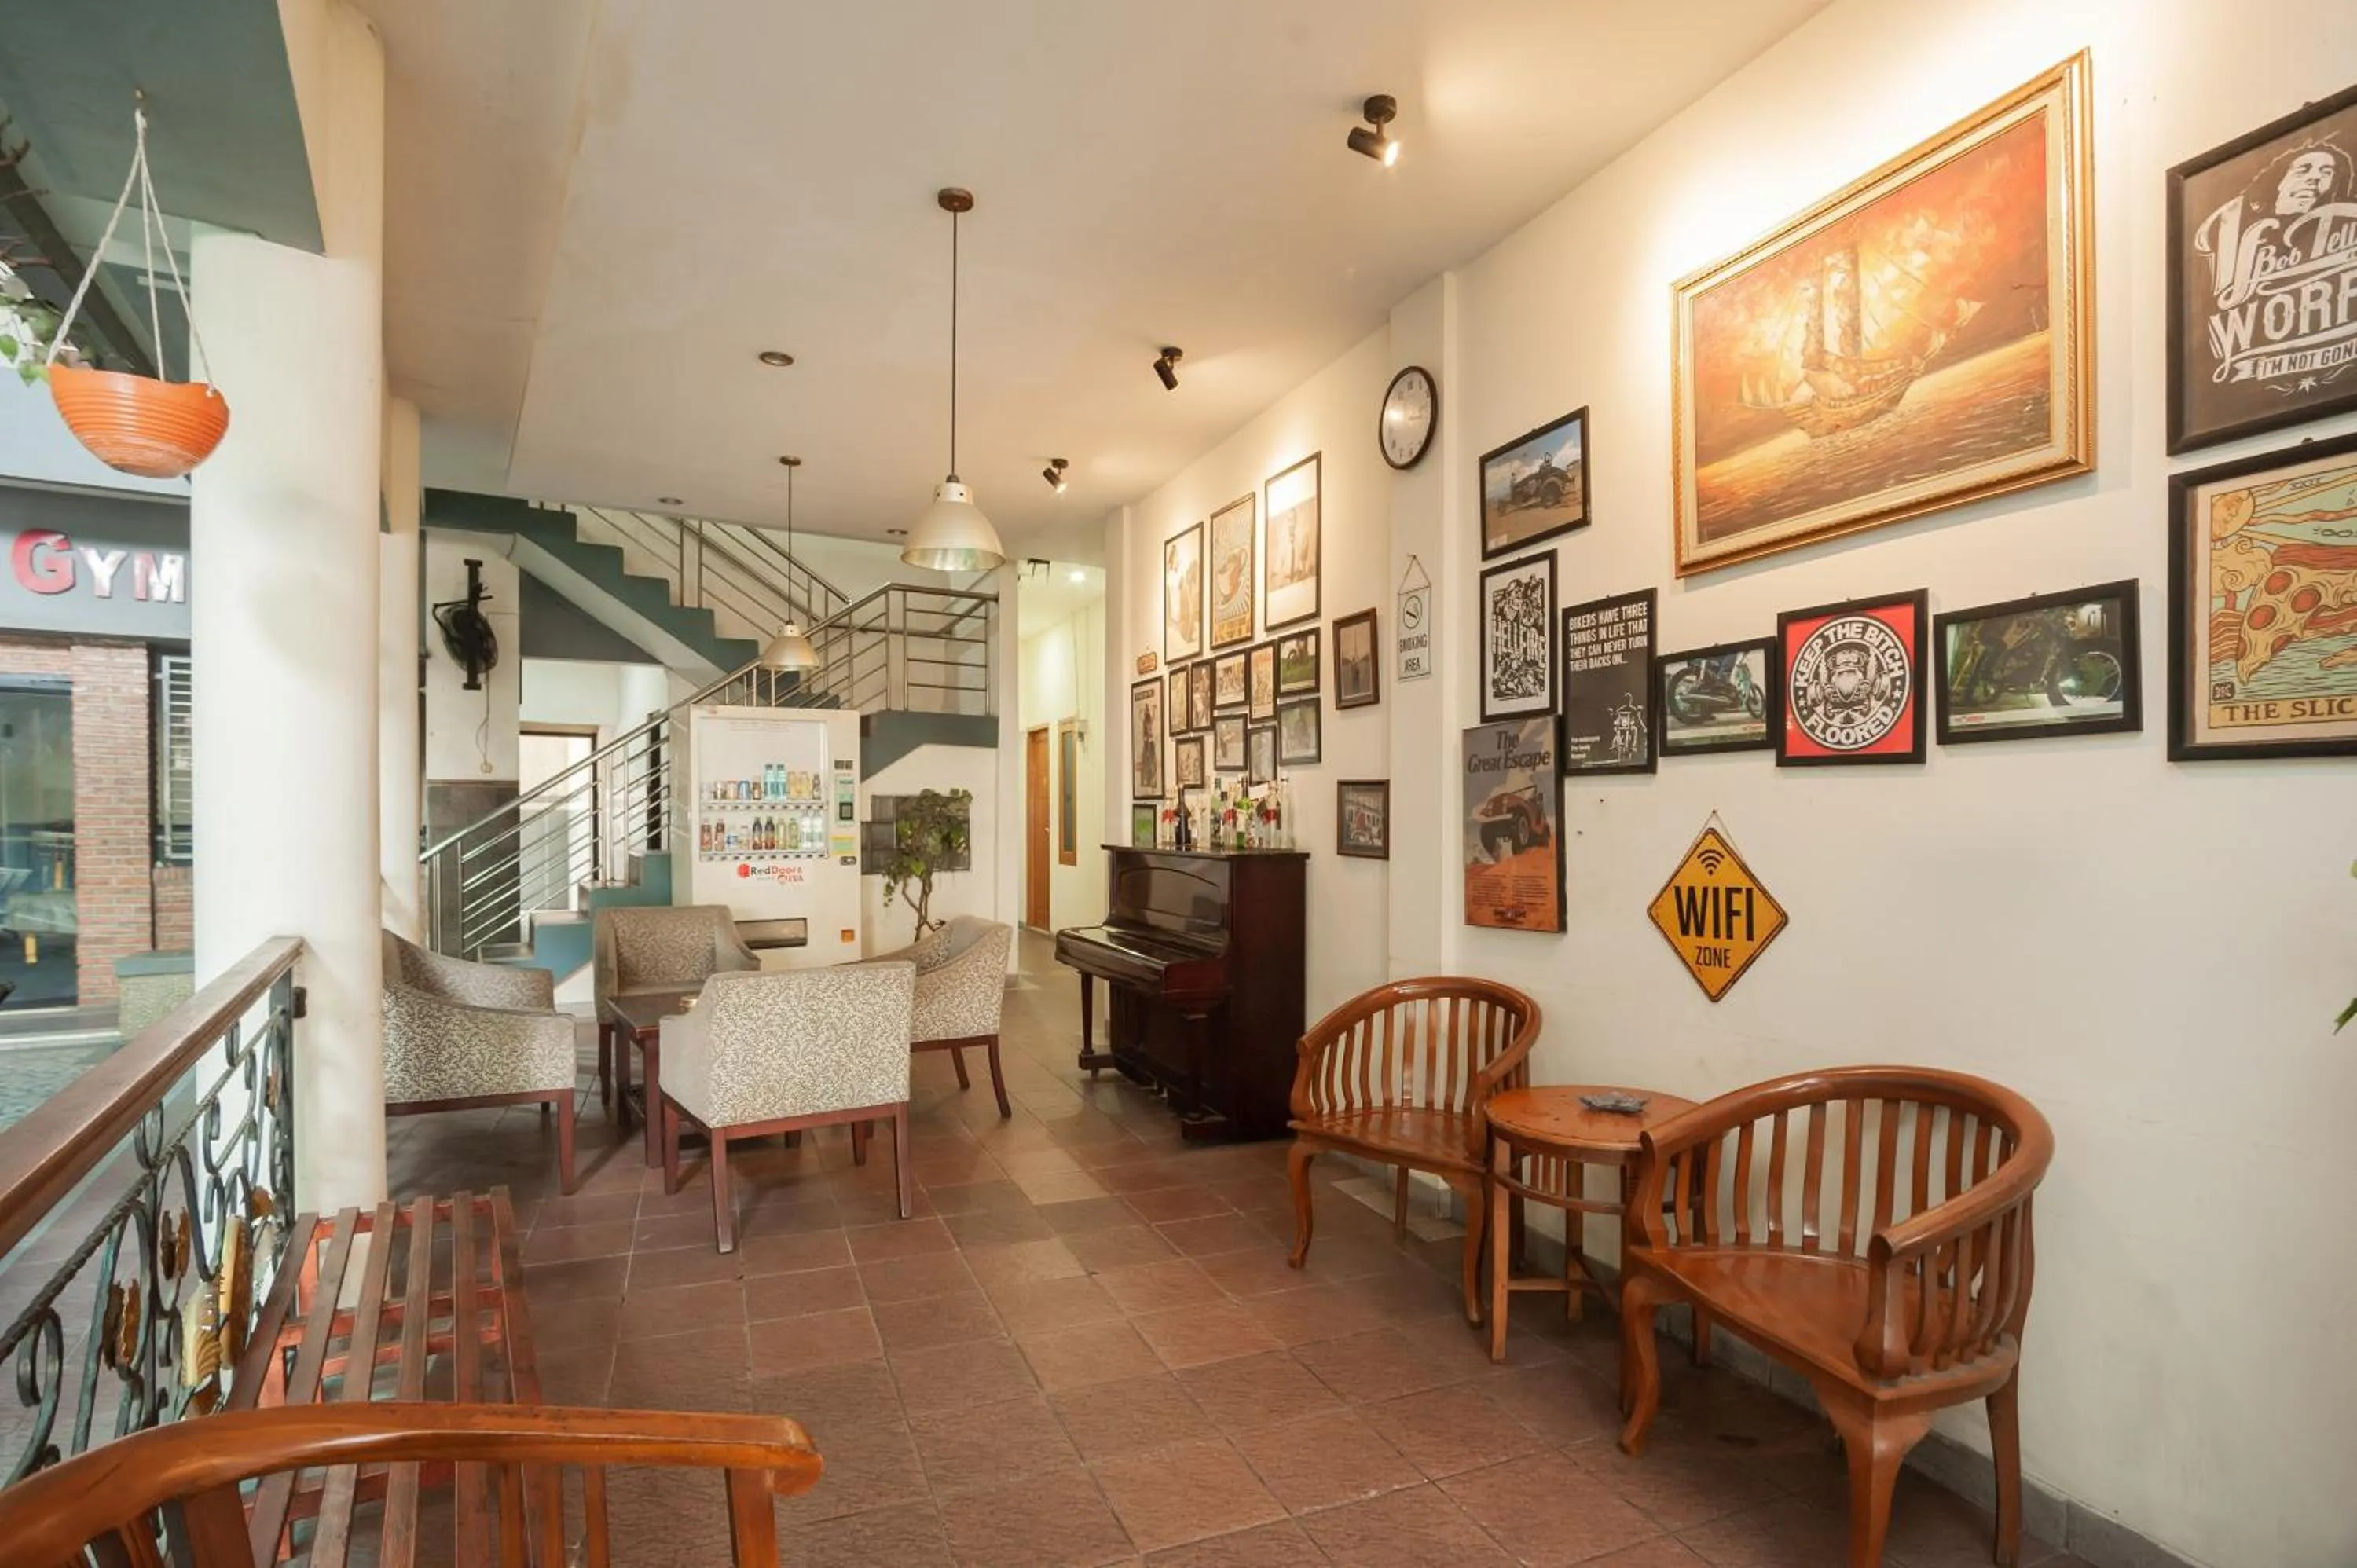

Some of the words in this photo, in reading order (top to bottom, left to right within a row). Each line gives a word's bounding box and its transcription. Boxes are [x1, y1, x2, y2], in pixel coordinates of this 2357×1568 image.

[2255, 245, 2303, 275] Bob
[2262, 358, 2282, 376] I'M
[2287, 353, 2315, 371] NOT
[2320, 341, 2357, 366] GON
[10, 528, 186, 604] GYM
[1569, 612, 1597, 631] BIKERS
[1598, 607, 1620, 625] HAVE
[1621, 601, 1648, 620] THREE
[1608, 622, 1626, 639] LIFE
[1627, 618, 1648, 636] THAT
[1794, 639, 1824, 687] KEEP
[1824, 622, 1864, 643] THE
[1863, 625, 1905, 678] BITCH
[1805, 706, 1895, 744] FLOORED
[2222, 702, 2280, 722] THE
[1496, 730, 1519, 750] The
[1468, 753, 1501, 774] Great
[1504, 750, 1550, 773] Escape
[1674, 885, 1755, 942] WIFI
[1695, 945, 1732, 969] ZONE
